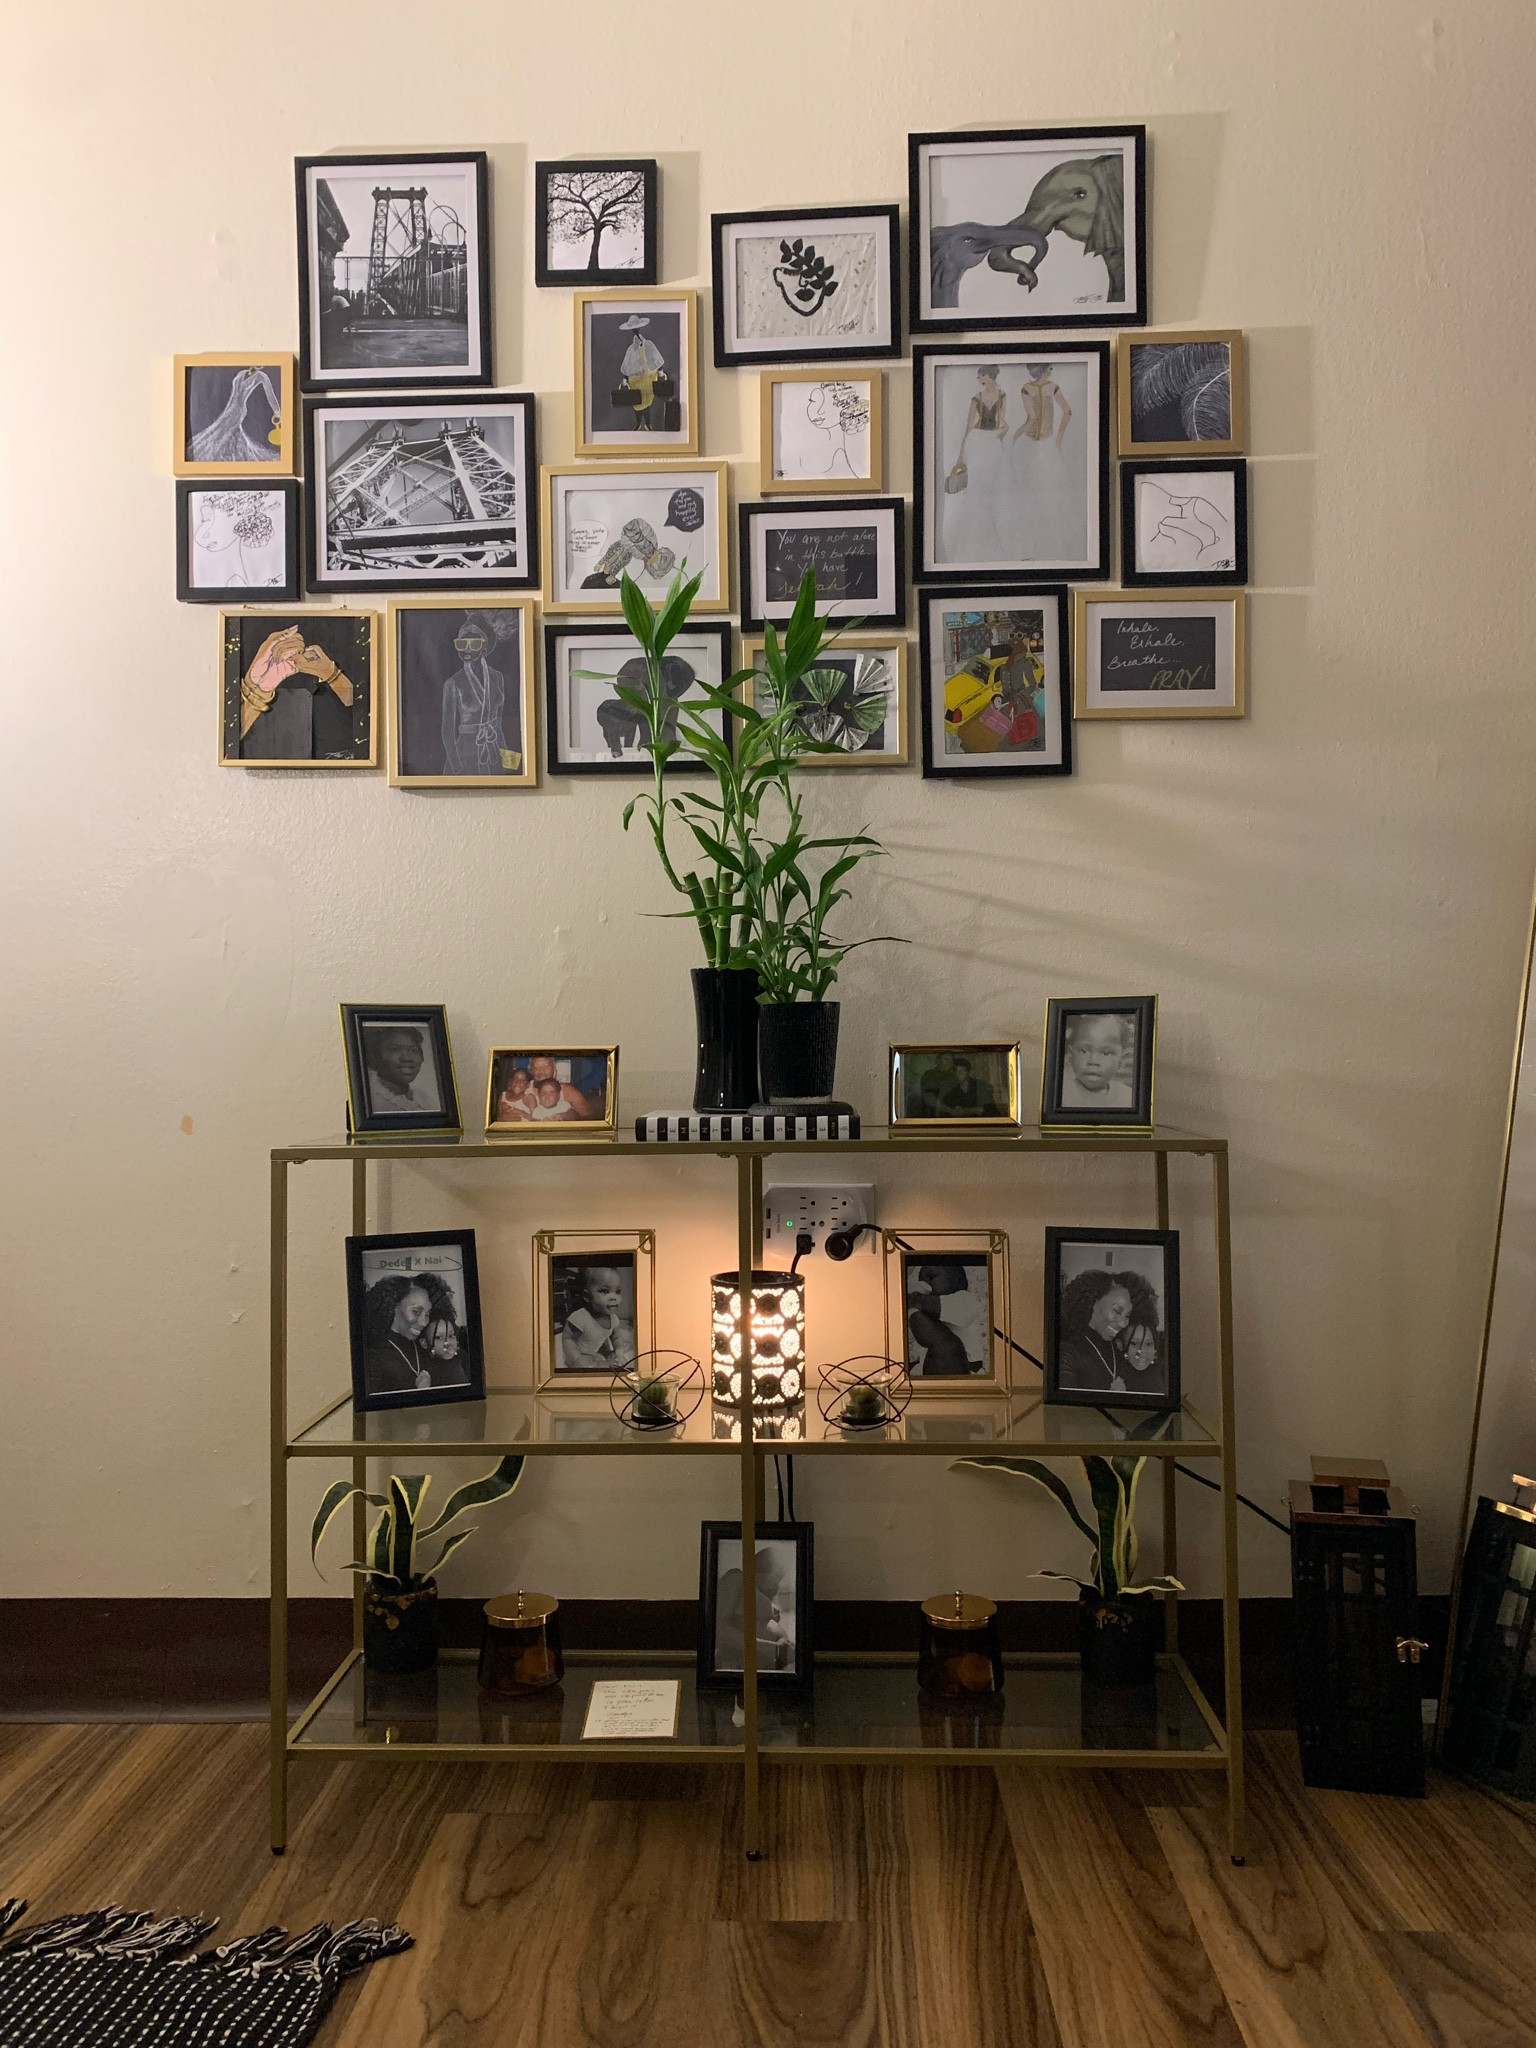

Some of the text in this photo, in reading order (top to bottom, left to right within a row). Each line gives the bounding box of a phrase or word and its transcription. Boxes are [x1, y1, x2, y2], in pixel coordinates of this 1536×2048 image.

[777, 529, 876, 550] You are not alone
[785, 549, 794, 561] in
[830, 544, 871, 559] battle.
[822, 562, 849, 573] have
[1117, 620, 1159, 635] Inhale,
[1130, 632, 1185, 650] Exhale,
[424, 1255, 443, 1265] Nai
